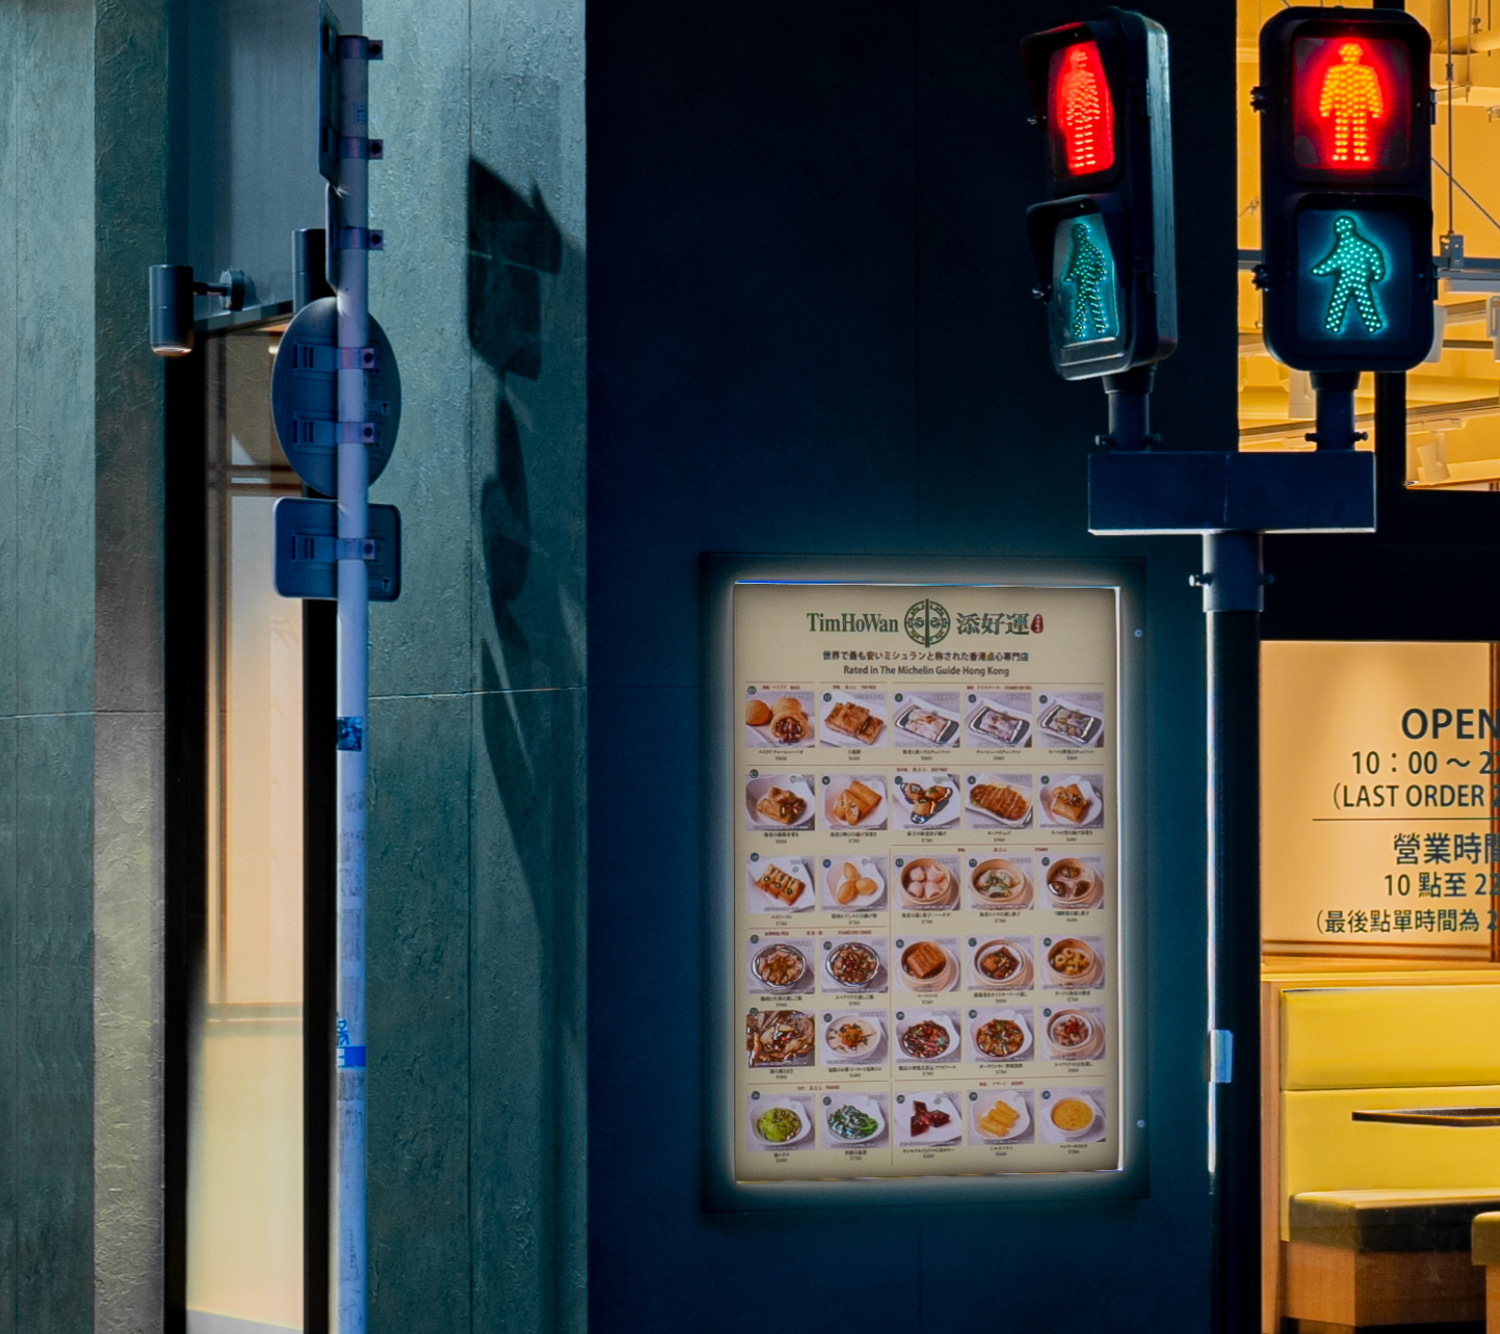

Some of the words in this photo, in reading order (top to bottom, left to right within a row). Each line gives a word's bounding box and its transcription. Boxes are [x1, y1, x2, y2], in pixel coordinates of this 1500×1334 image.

[806, 612, 899, 633] TimHoWan
[956, 612, 1031, 636] 添好運
[843, 665, 869, 675] Rated
[870, 665, 879, 675] in
[880, 665, 896, 675] The
[898, 665, 934, 675] Michelin
[935, 665, 961, 675] Guide
[963, 665, 986, 677] Hong
[987, 666, 1010, 677] Kong
[1406, 784, 1485, 808] ORDER
